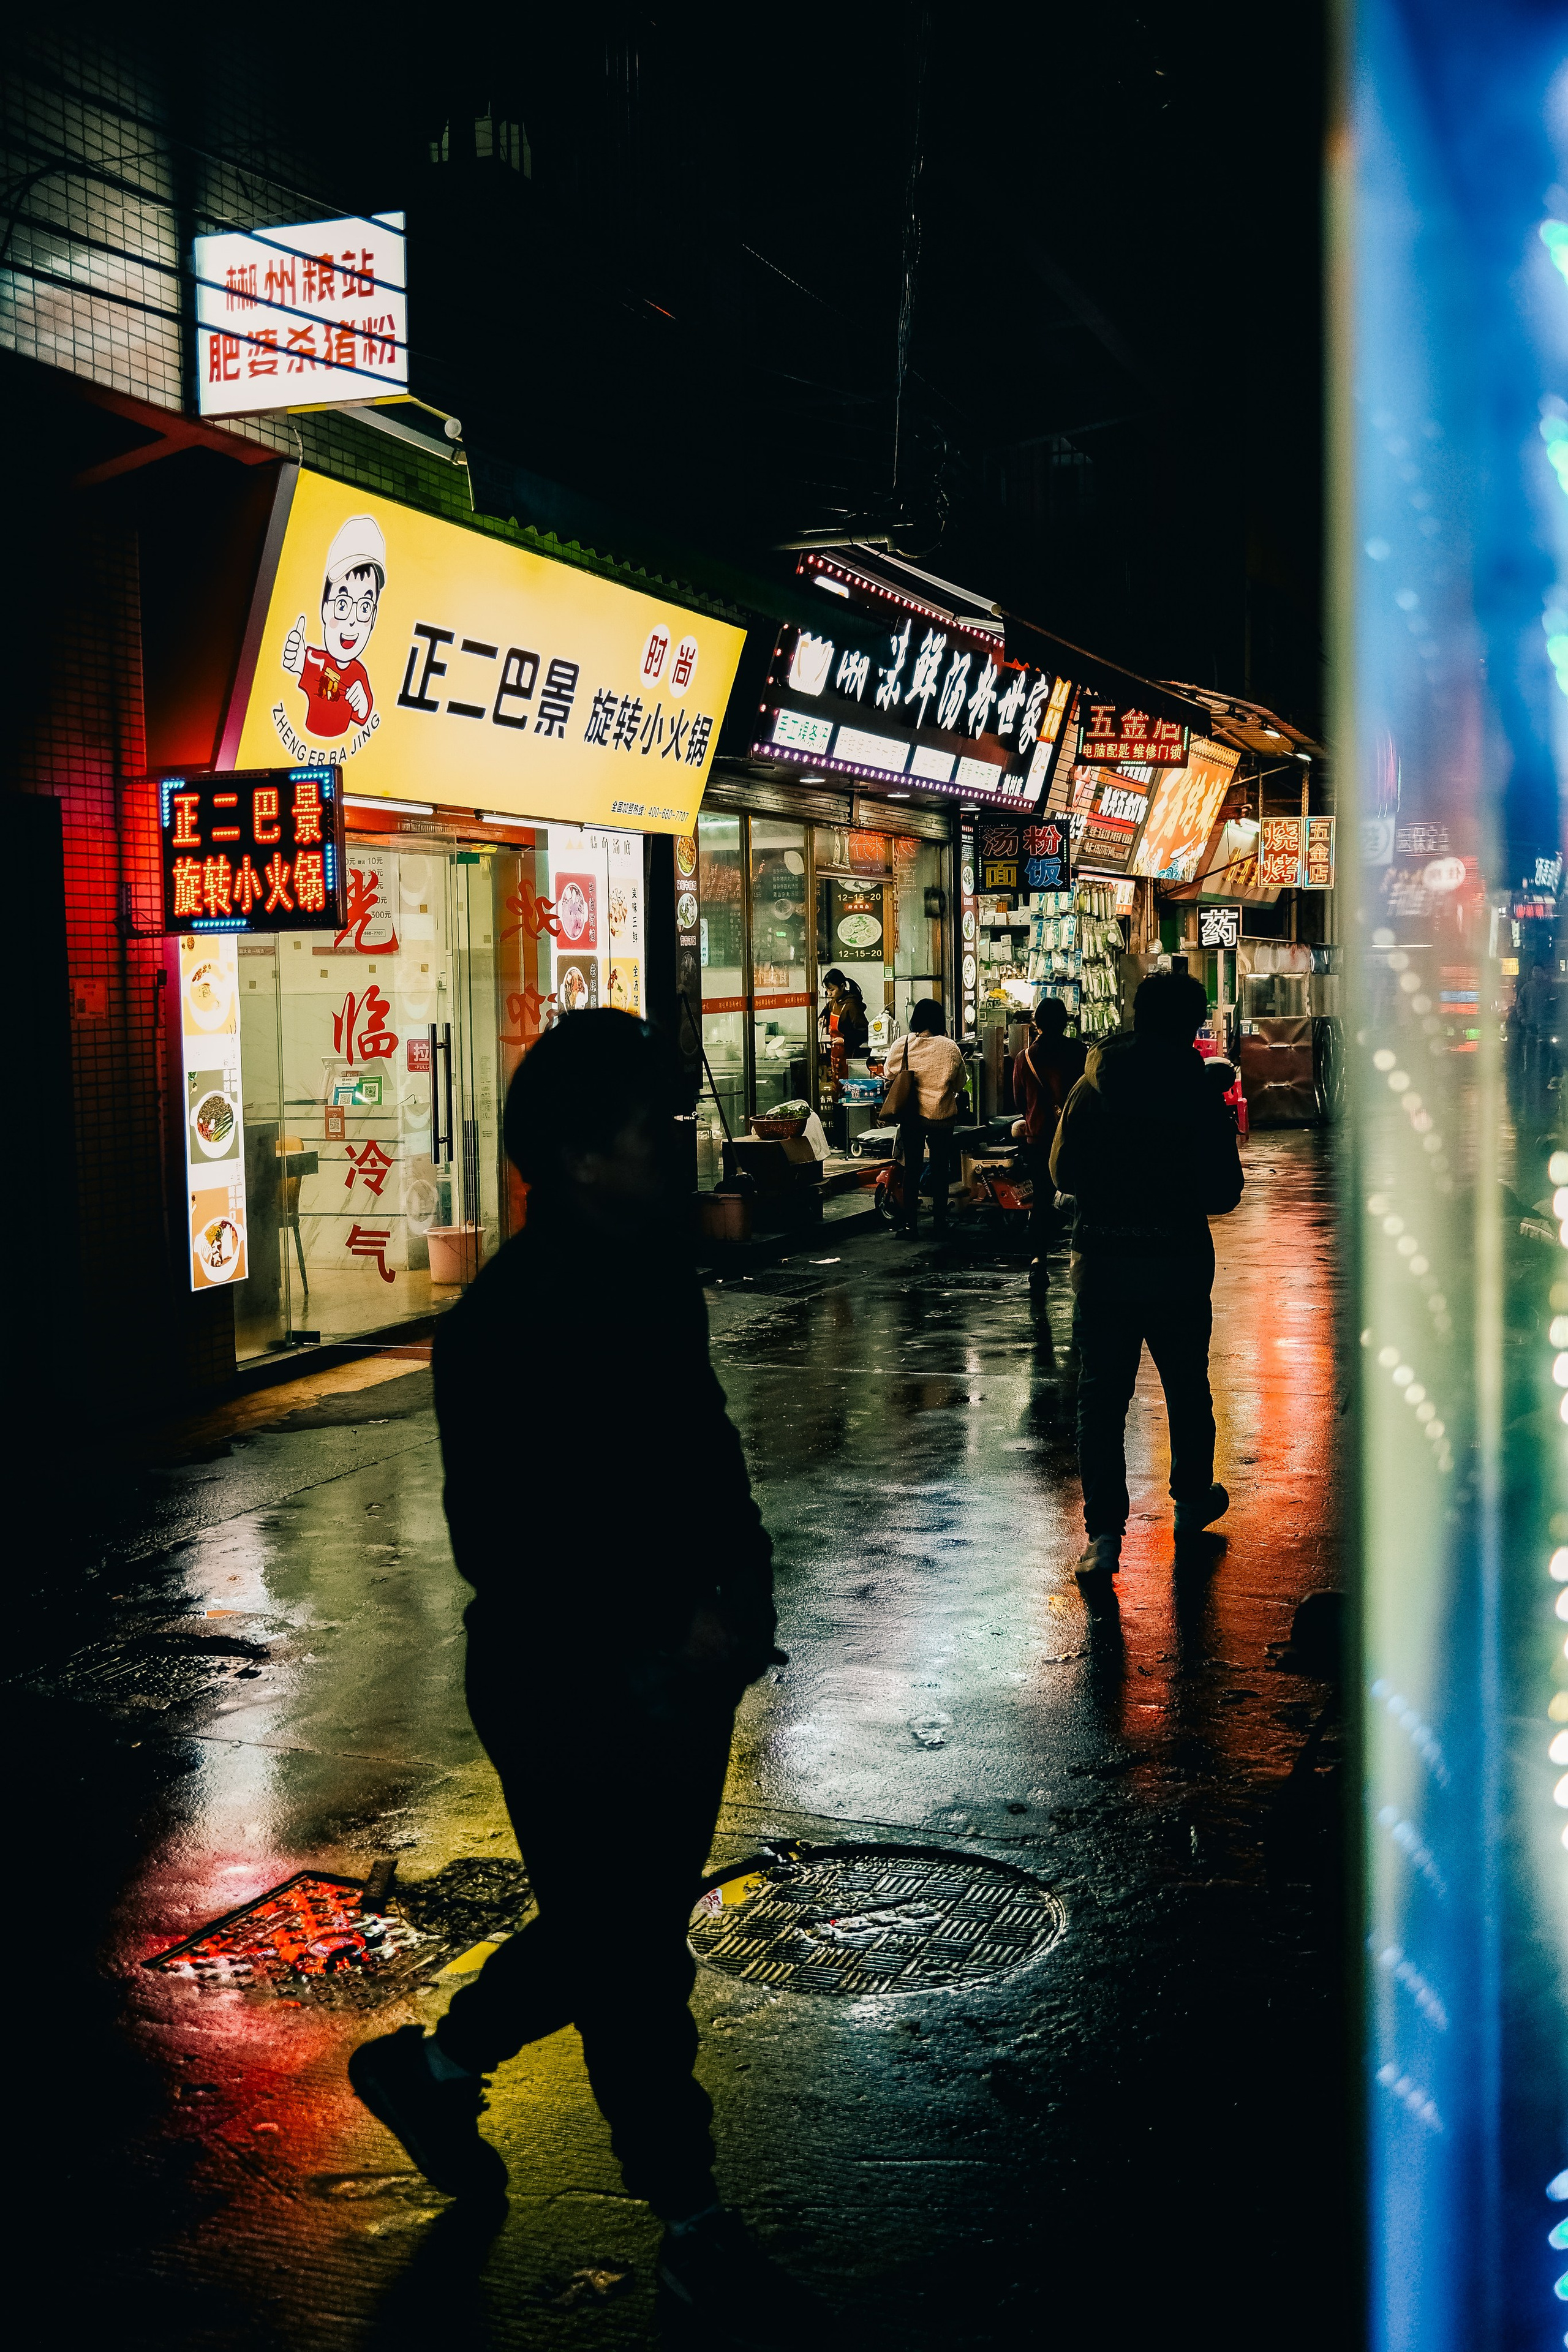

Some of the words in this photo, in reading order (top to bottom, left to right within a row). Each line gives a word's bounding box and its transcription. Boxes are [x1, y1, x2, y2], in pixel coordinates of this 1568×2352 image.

[225, 248, 375, 312] 郴州粮站
[397, 622, 579, 739] 正二巴景
[644, 635, 696, 687] 时尚
[273, 703, 306, 761] ZHENG
[308, 750, 325, 766] ER
[330, 747, 347, 765] BA
[351, 714, 380, 755] JING
[584, 688, 714, 767] 旋转小火锅
[1082, 742, 1130, 759] 电脑配匙
[1133, 742, 1182, 760] 维修门锁
[172, 782, 323, 848] 正二巴景
[648, 806, 689, 822] 400-660-7707
[982, 825, 1062, 857] 汤粉
[368, 856, 383, 865] 10元
[983, 858, 1063, 888] 面饭
[1263, 821, 1299, 883] 烧烤
[1308, 822, 1330, 884] 五金店
[172, 850, 326, 918] 旋转小火锅
[837, 893, 881, 902] 12-15-20
[1200, 909, 1238, 947] 药
[331, 867, 399, 1067] 光临
[413, 1043, 429, 1061] 拉
[344, 1139, 396, 1283] 冷气
